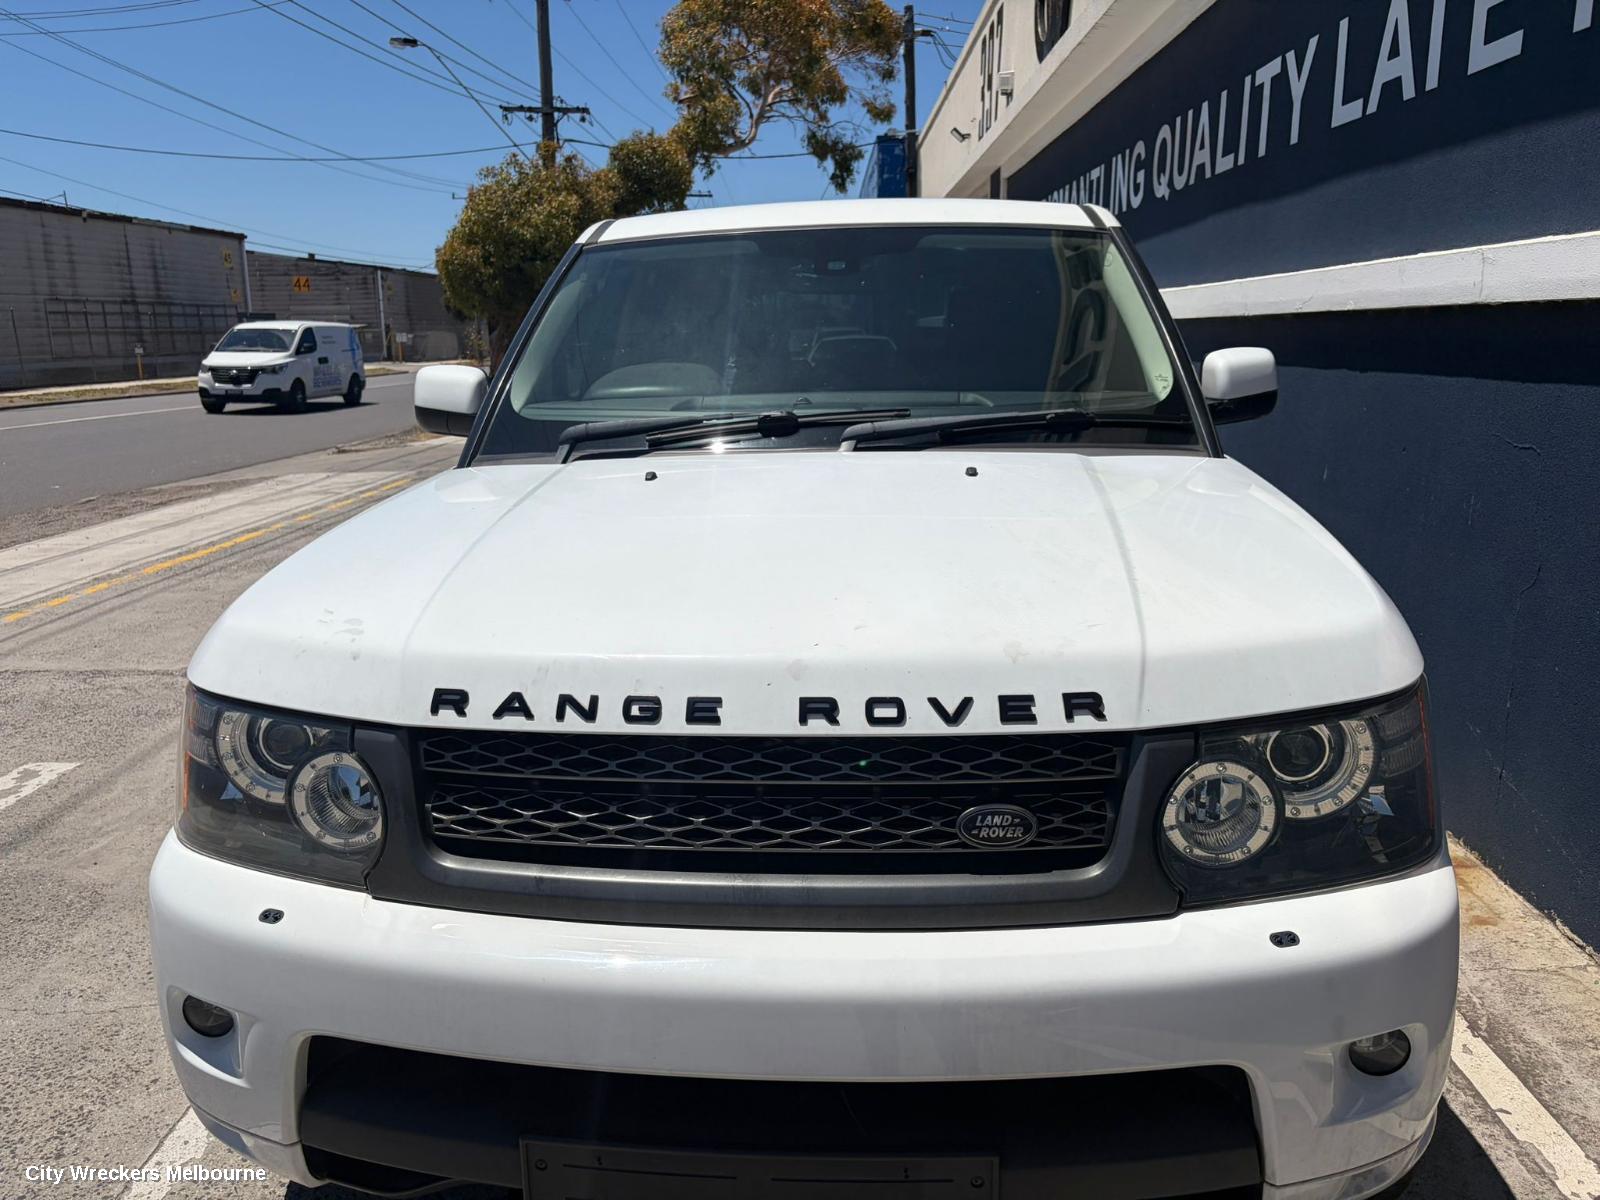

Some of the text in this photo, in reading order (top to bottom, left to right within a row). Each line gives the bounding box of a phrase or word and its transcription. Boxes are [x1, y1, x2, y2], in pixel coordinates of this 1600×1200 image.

[1152, 34, 1320, 201] QUALITY
[294, 277, 310, 292] 44
[430, 687, 1107, 727] RANGE ROVER
[975, 815, 1012, 826] LAND
[979, 826, 1024, 838] ROVER
